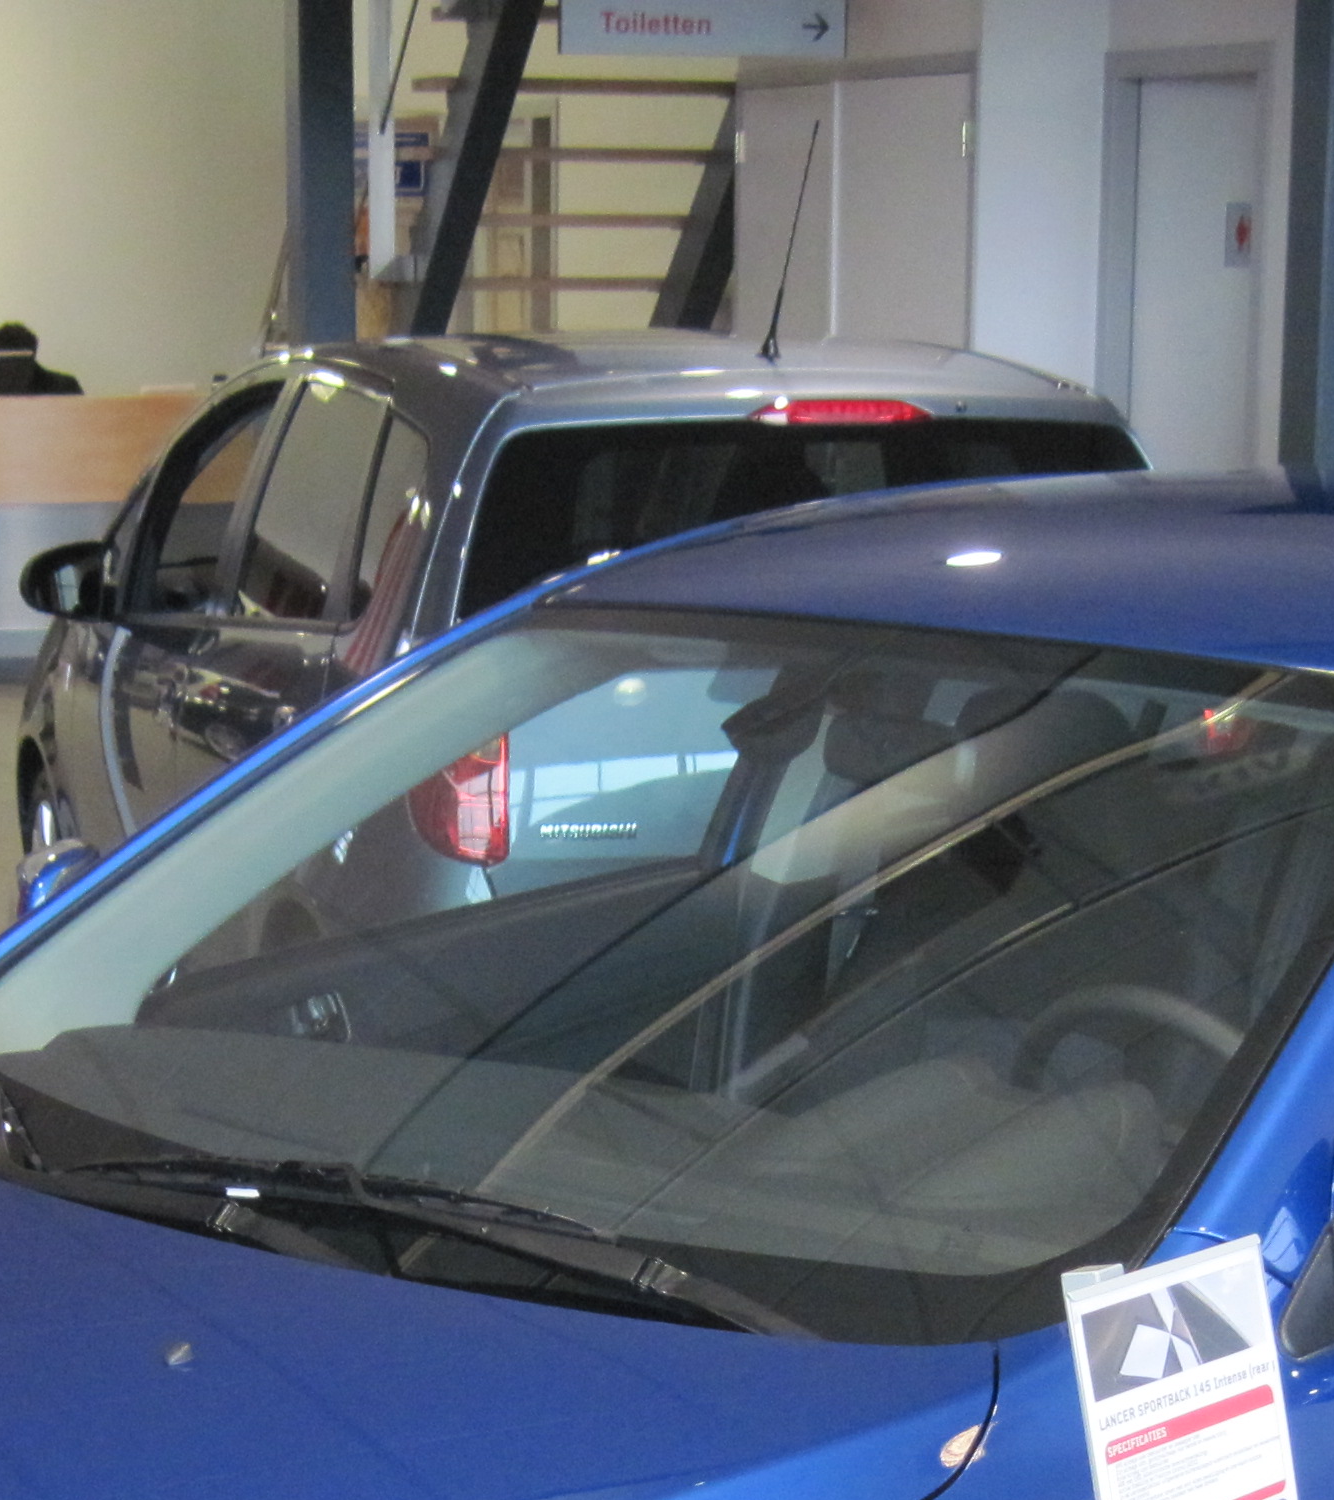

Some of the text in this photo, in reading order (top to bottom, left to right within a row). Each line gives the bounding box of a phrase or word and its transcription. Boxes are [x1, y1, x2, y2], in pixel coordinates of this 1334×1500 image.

[600, 11, 712, 35] Toiletten
[539, 822, 637, 839] MITSUBISHI
[1099, 1407, 1136, 1431] LANCER
[1138, 1388, 1192, 1417] SPORTBACK
[1194, 1380, 1212, 1398] 145
[1214, 1369, 1247, 1389] Intense
[1107, 1427, 1167, 1458] SPECIFICATIES
